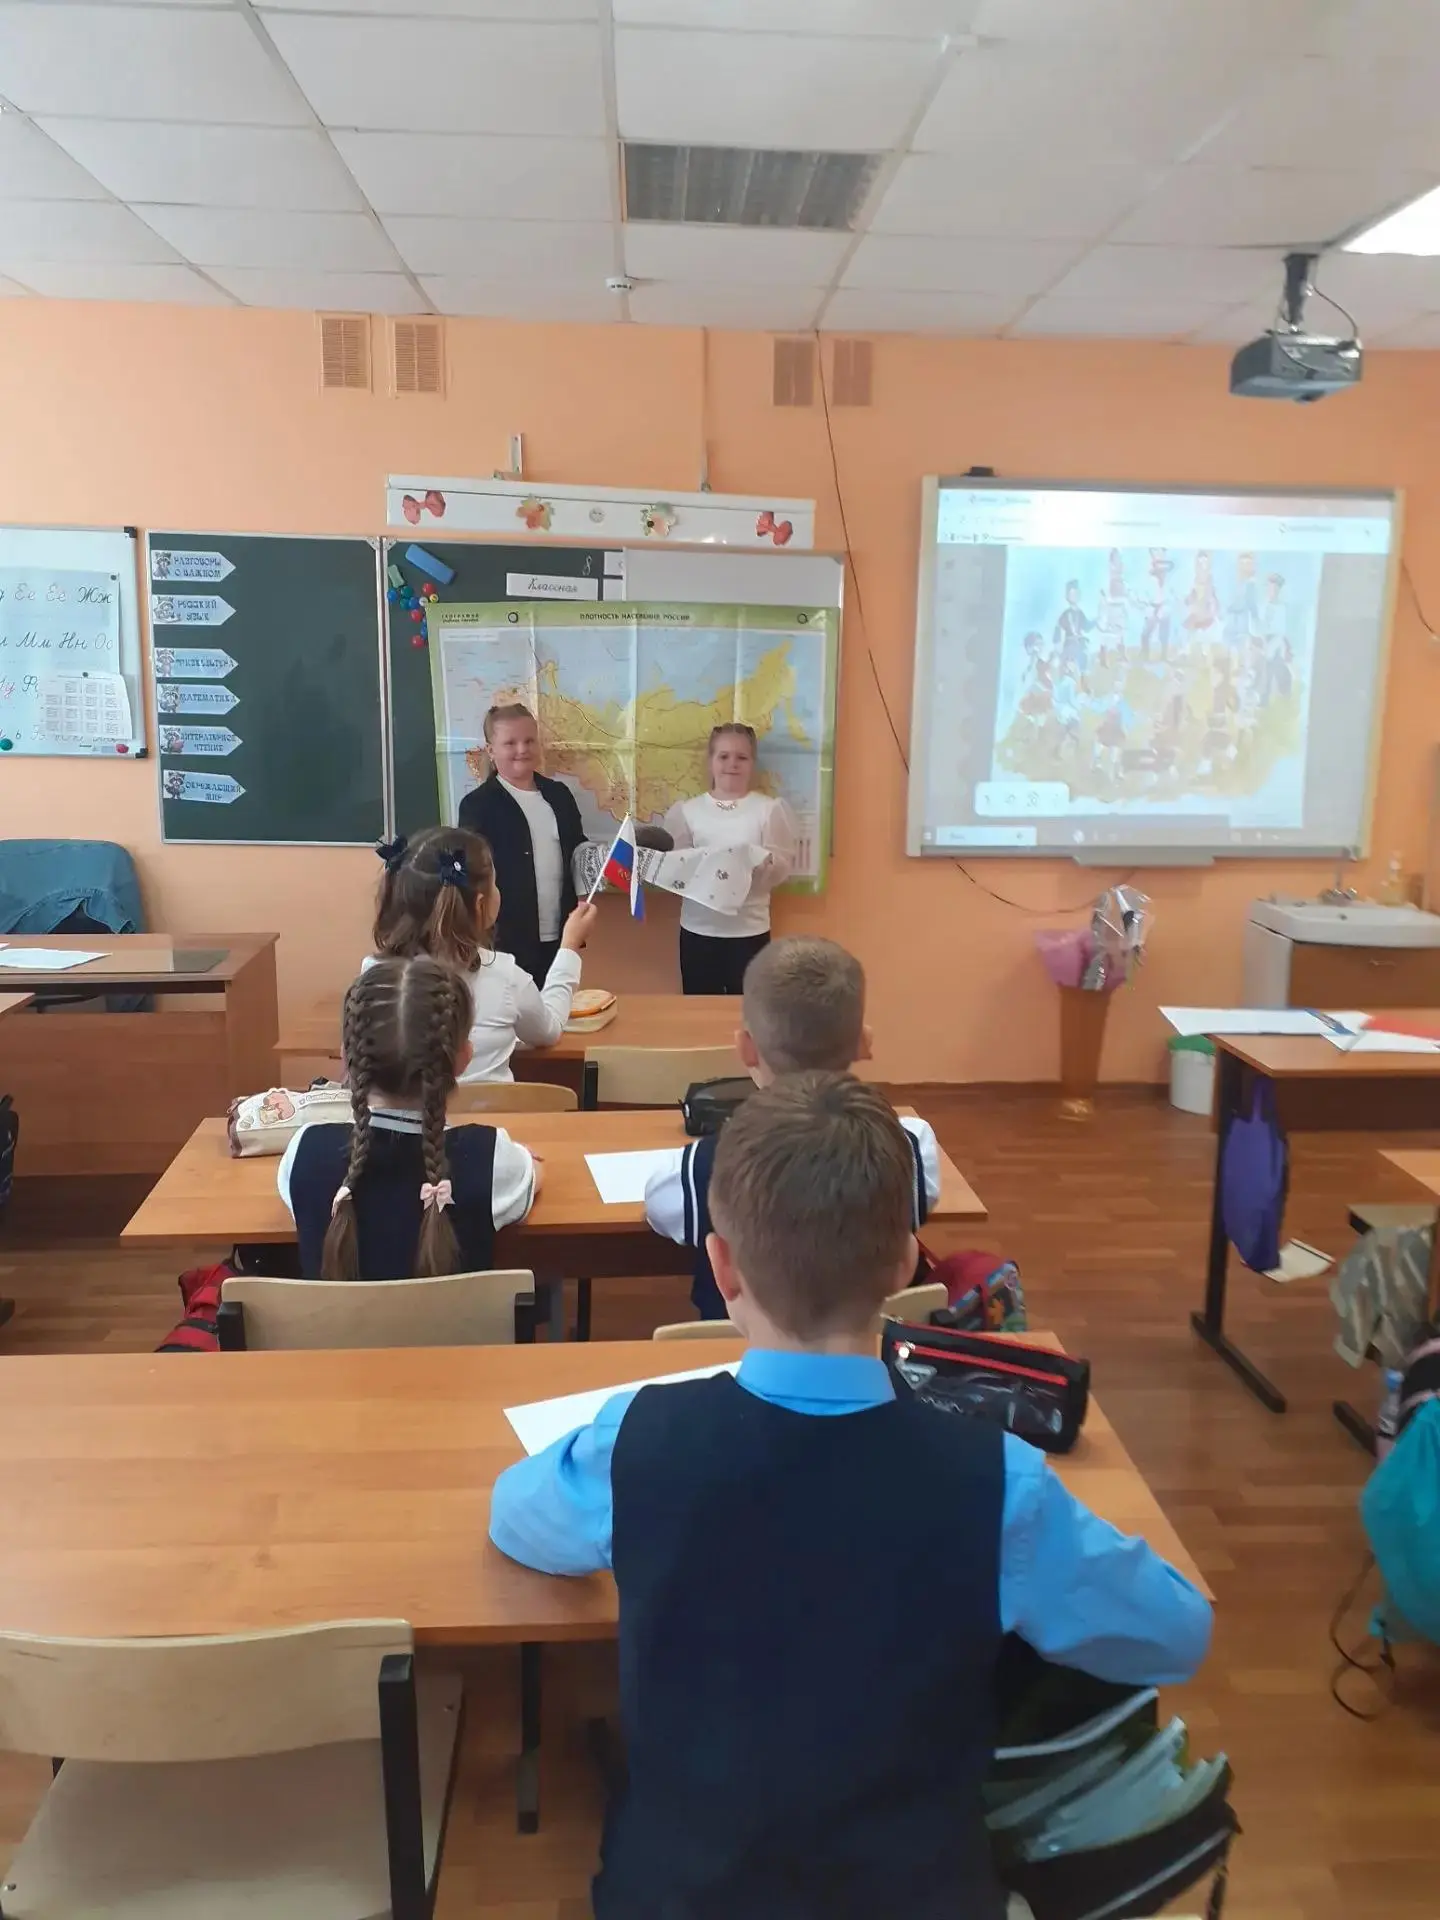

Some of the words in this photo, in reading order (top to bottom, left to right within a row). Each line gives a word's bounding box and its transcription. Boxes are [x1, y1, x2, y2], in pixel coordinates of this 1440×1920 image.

[173, 556, 222, 566] РАЗГОВОРЫ
[174, 568, 181, 577] О
[183, 568, 221, 577] ВАЖНОМ
[527, 577, 579, 593] Классная
[78, 586, 113, 604] Жж
[579, 612, 620, 621] ПЛОТНОСТЬ
[663, 613, 691, 621] РОССИИ
[15, 631, 52, 648] Мм
[58, 631, 89, 650] Нн
[179, 693, 237, 703] МАТЕМАТИКА
[194, 743, 224, 752] ЧТЕНИЕ
